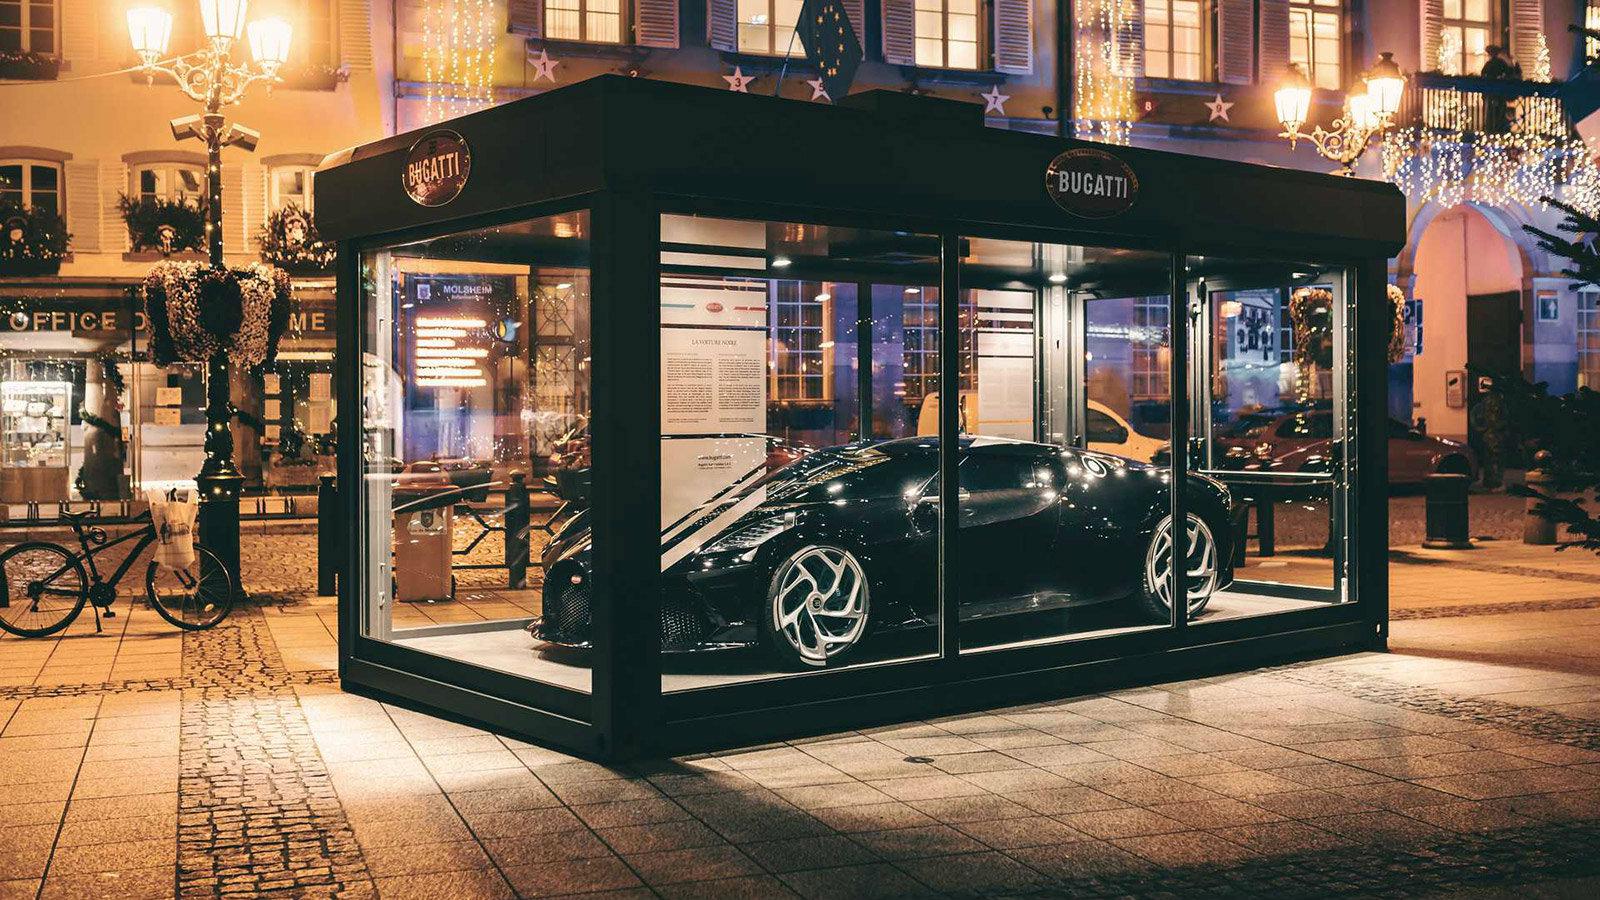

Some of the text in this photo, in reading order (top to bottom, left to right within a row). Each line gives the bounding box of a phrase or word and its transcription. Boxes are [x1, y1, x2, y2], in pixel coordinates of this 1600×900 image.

[541, 62, 547, 72] 1
[735, 78, 741, 87] 3
[993, 96, 998, 105] 7
[1145, 101, 1152, 111] 8
[408, 151, 460, 187] BUGATTI
[1059, 170, 1127, 198] BUGATTI
[443, 284, 492, 294] MOLSHEIM
[9, 311, 116, 332] OFFICE
